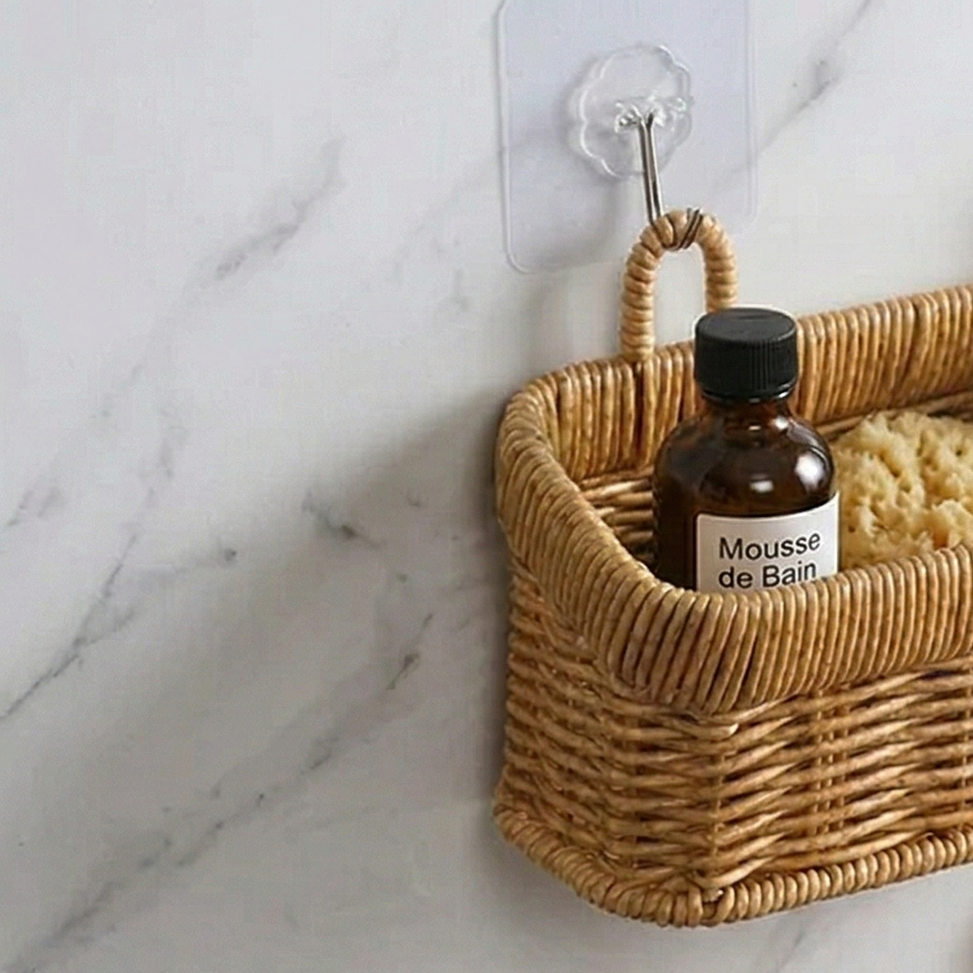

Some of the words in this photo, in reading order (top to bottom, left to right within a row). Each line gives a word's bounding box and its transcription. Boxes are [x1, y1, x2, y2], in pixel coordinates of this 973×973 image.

[718, 532, 821, 561] Mousse
[718, 566, 753, 589] de
[762, 560, 817, 588] Bain
